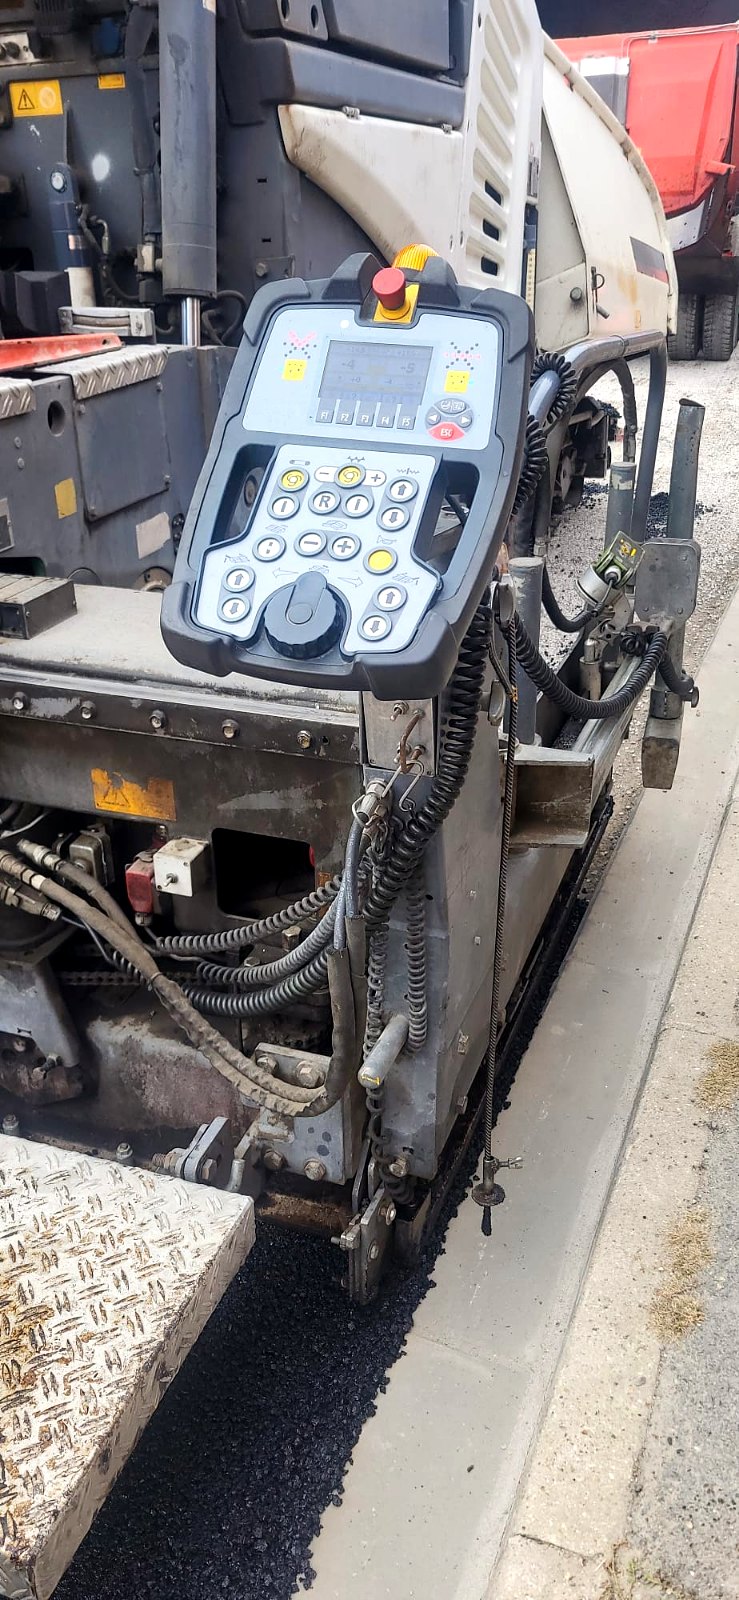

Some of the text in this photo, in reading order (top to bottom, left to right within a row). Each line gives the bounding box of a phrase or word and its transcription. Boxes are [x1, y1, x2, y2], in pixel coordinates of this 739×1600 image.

[320, 411, 328, 420] F1
[340, 413, 349, 422] F2
[360, 414, 369, 423] F3
[381, 416, 390, 425] F4
[402, 417, 410, 426] F5
[440, 427, 453, 437] ESC
[318, 495, 331, 508] R
